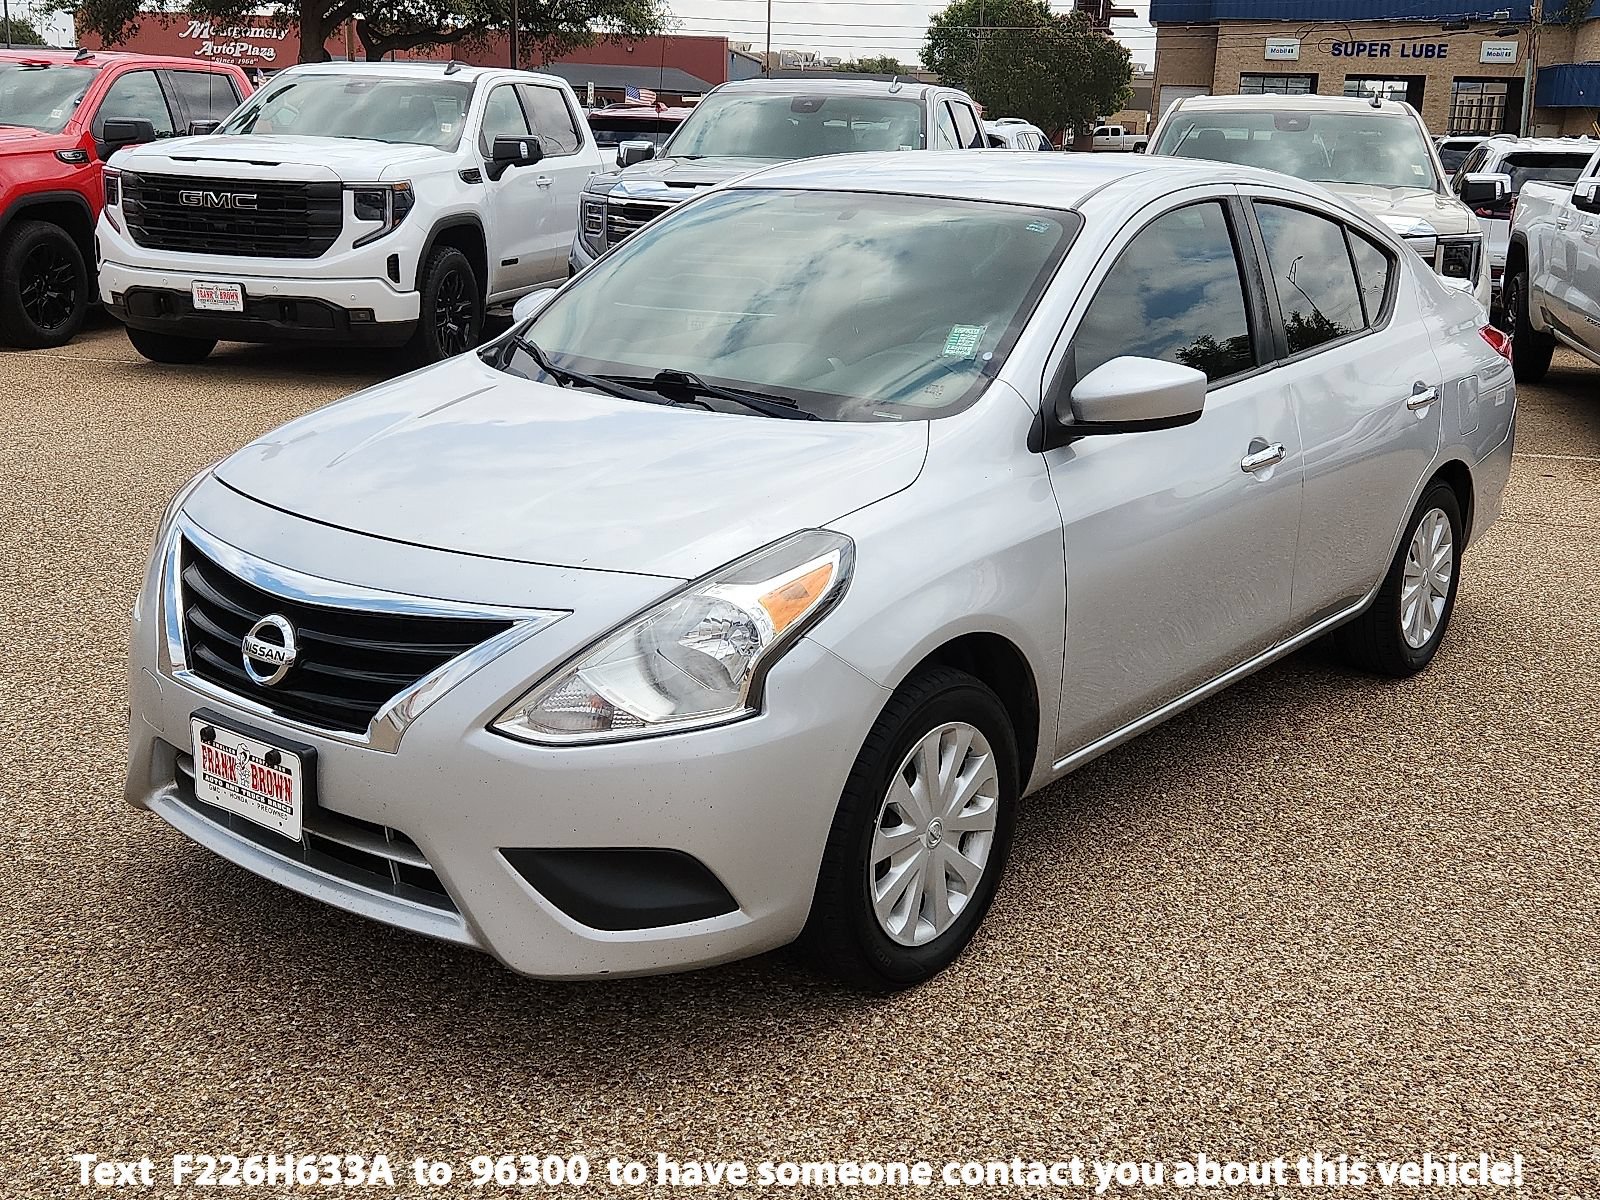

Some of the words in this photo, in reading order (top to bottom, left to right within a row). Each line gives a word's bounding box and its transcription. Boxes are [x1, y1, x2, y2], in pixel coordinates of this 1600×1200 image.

[1331, 41, 1391, 57] SUPER
[1400, 43, 1449, 58] LUBE
[178, 190, 258, 210] GMC
[243, 639, 286, 662] NISSAN
[200, 744, 239, 784] FRANK
[250, 762, 293, 806] BROWN
[204, 774, 224, 787] AUTO
[225, 782, 240, 793] AND
[240, 788, 266, 804] TRUCK
[267, 797, 292, 814] RANCH
[208, 783, 221, 794] GMC
[229, 792, 249, 805] HONDA
[256, 802, 288, 821] PREOWNED
